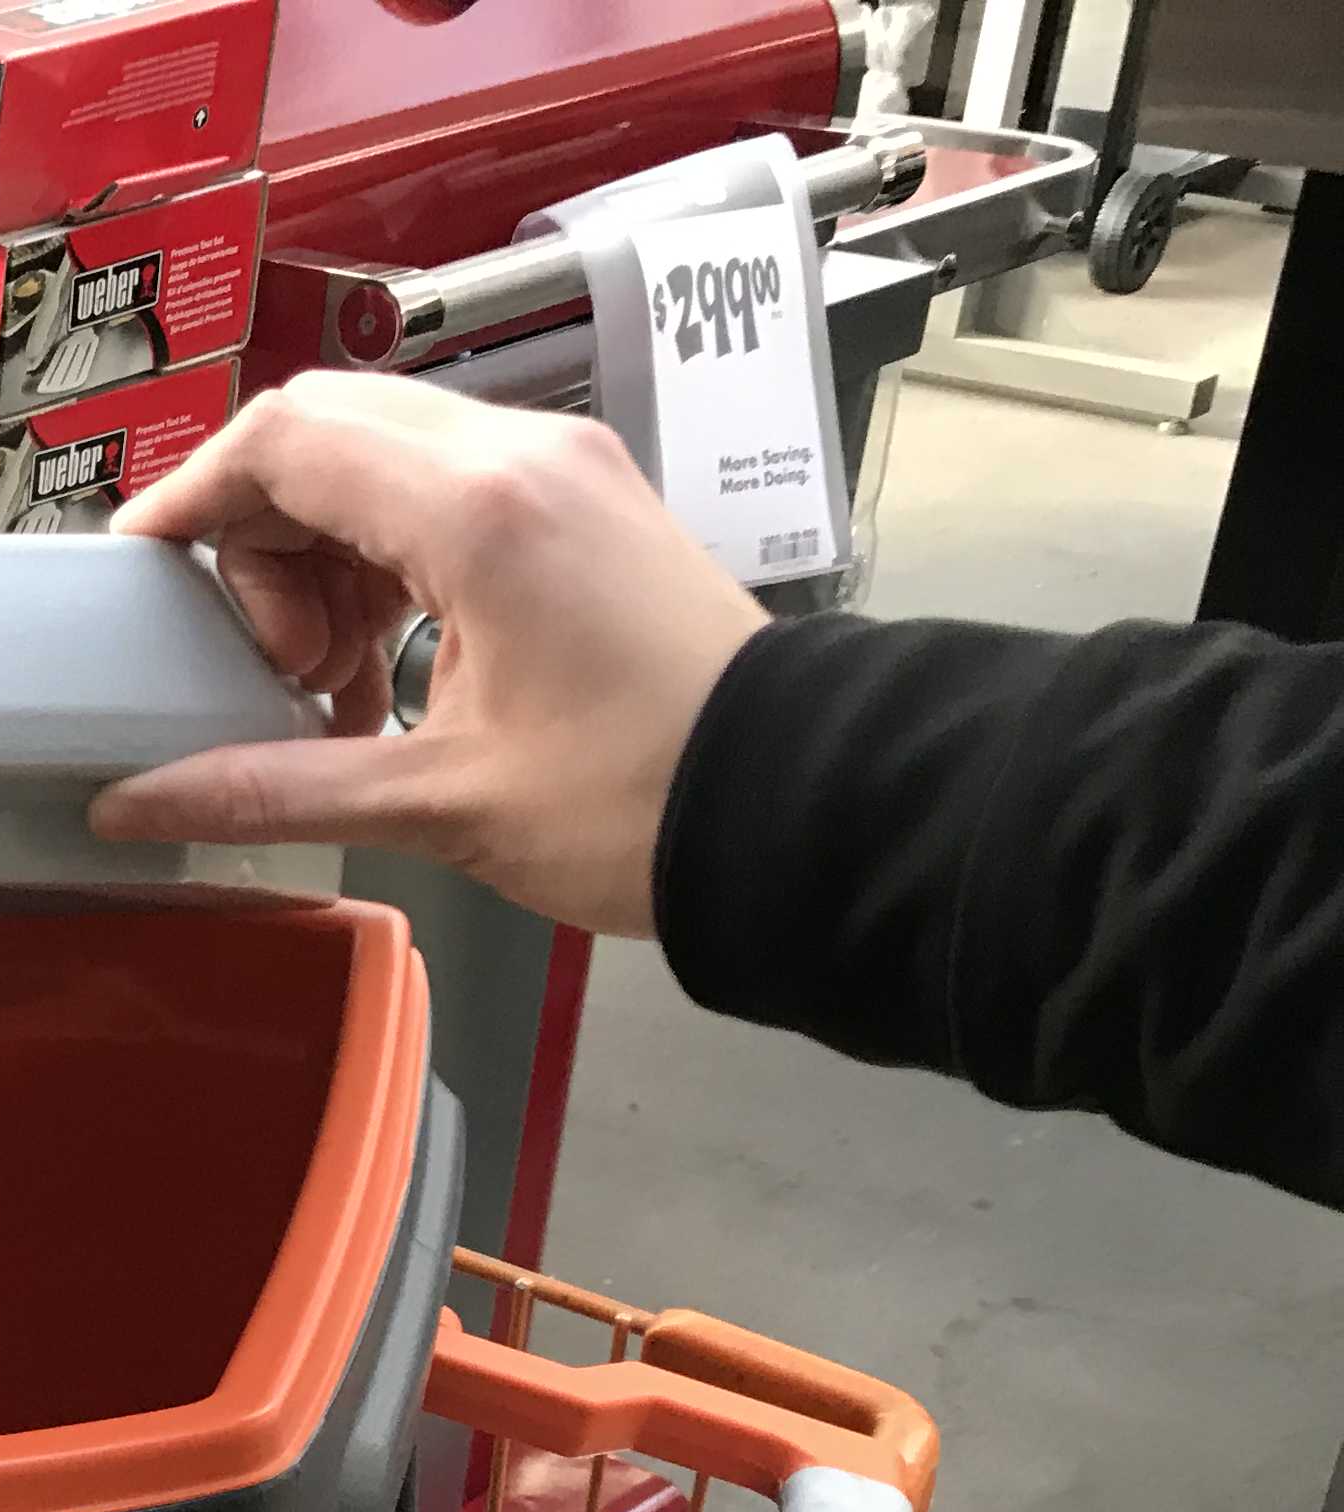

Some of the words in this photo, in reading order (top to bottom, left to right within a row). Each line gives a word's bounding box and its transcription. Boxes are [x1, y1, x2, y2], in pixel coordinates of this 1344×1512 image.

[77, 266, 140, 321] weber
[38, 444, 103, 496] weber
[718, 456, 758, 474] More
[720, 478, 760, 495] More
